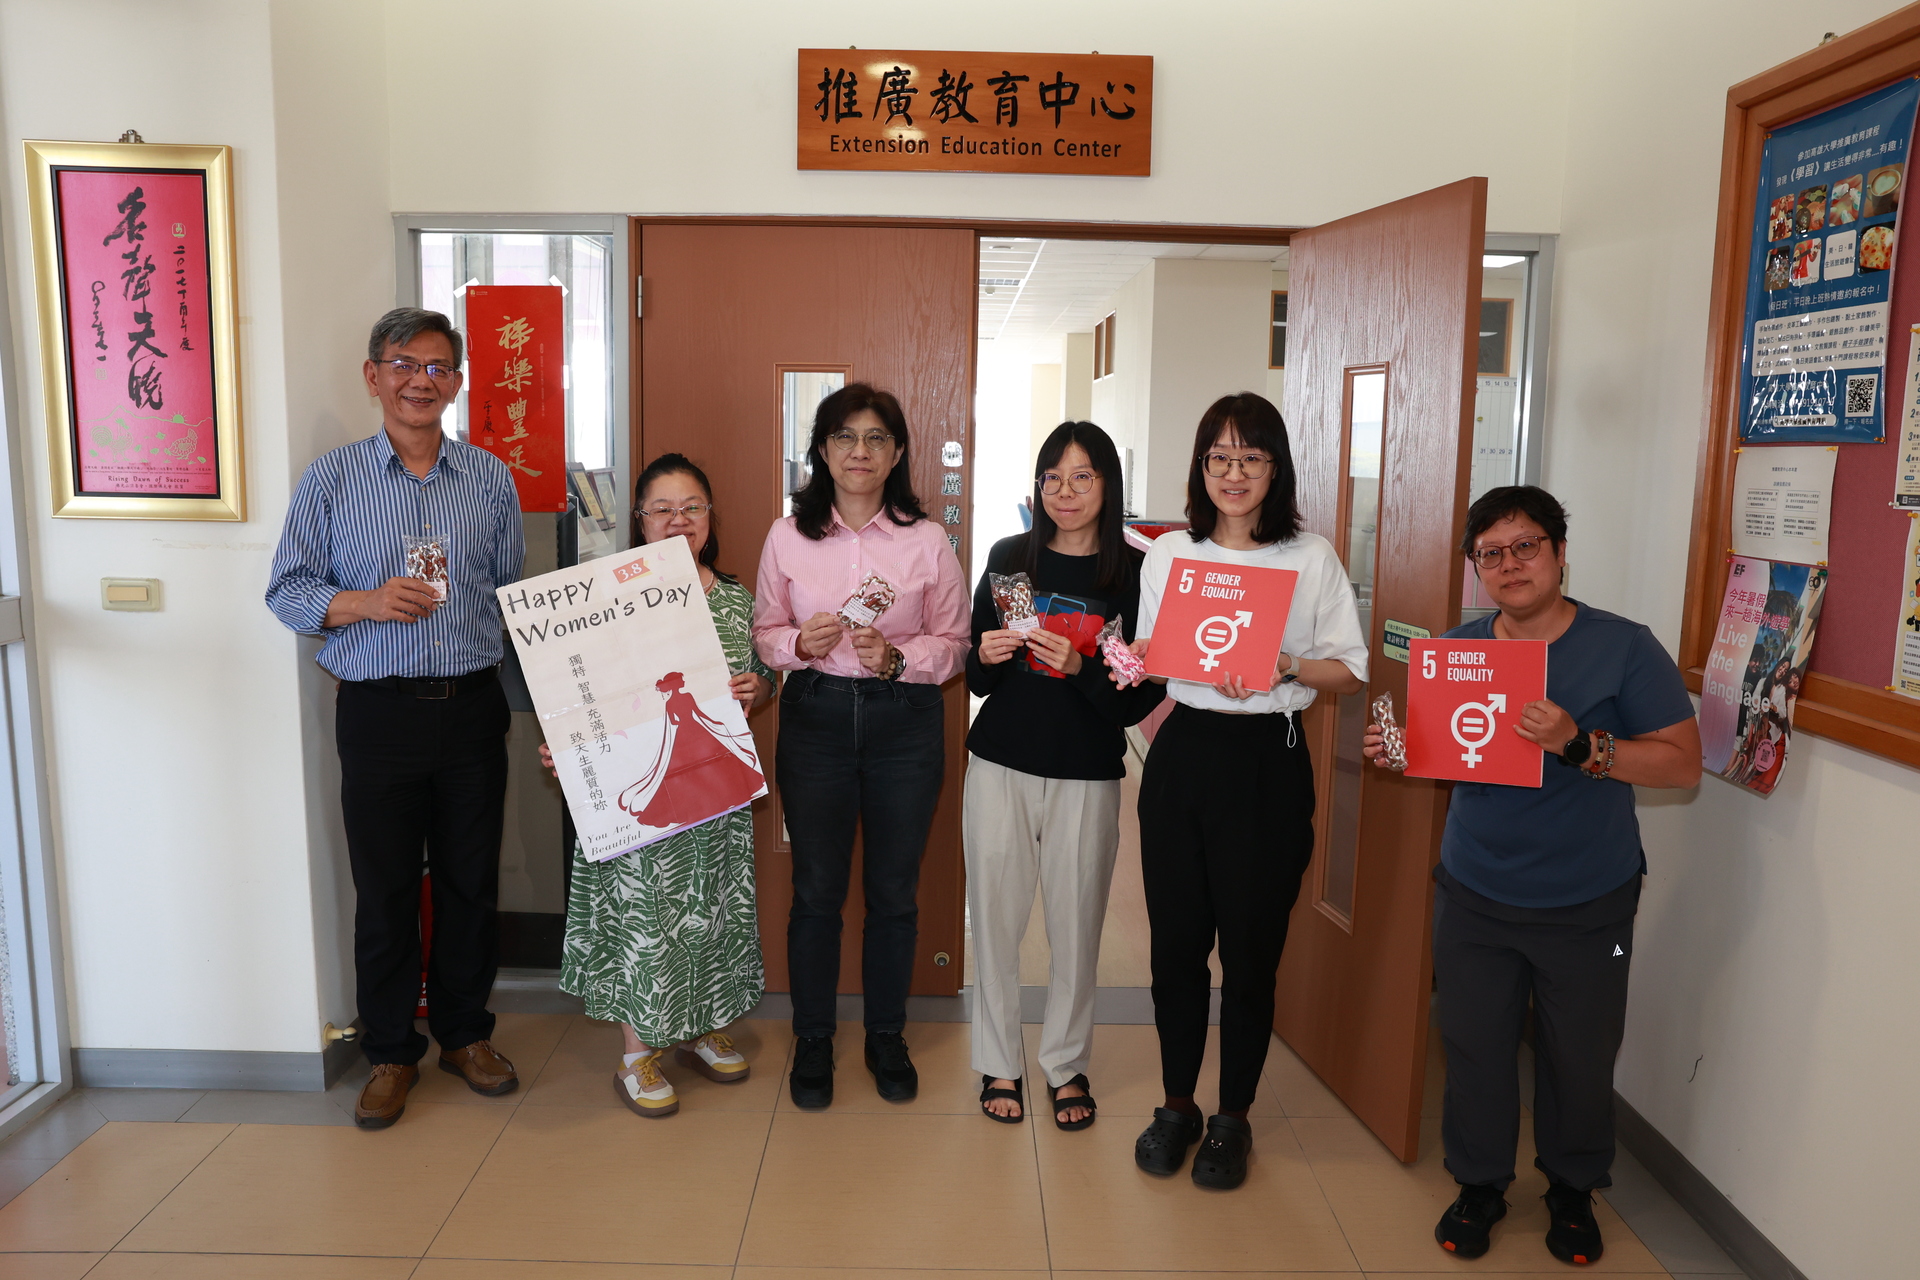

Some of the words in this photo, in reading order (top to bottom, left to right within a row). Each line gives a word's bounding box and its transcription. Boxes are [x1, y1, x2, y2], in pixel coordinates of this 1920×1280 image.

[814, 66, 1136, 129] 推廣教育中心
[830, 134, 930, 155] Extension
[941, 136, 1042, 156] Education
[1053, 138, 1121, 157] Center
[108, 475, 129, 483] Rising
[155, 475, 162, 484] of
[617, 561, 643, 582] 3.8
[1178, 568, 1196, 594] 5
[1204, 572, 1241, 586] GENDER
[1733, 564, 1746, 576] EF
[507, 577, 594, 614] Happy
[1201, 585, 1246, 601] EQUALITY
[1729, 588, 1767, 609] 今年暑假
[516, 598, 636, 646] Women's
[641, 584, 692, 609] Day
[1724, 607, 1791, 631] 來一趟海外遊學
[1718, 622, 1748, 648] Live
[1422, 650, 1437, 679] 5
[1447, 651, 1486, 665] GENDER
[1711, 649, 1734, 673] the
[1447, 667, 1494, 682] EQUALITY
[568, 653, 586, 678] 獨特
[578, 681, 596, 705] 智慧
[587, 708, 611, 755] 充滿活力
[1706, 673, 1771, 715] language
[570, 731, 608, 812] 致天生麗質的妳
[587, 833, 607, 843] You
[613, 824, 631, 835] Are
[592, 830, 641, 856] Beautiful
